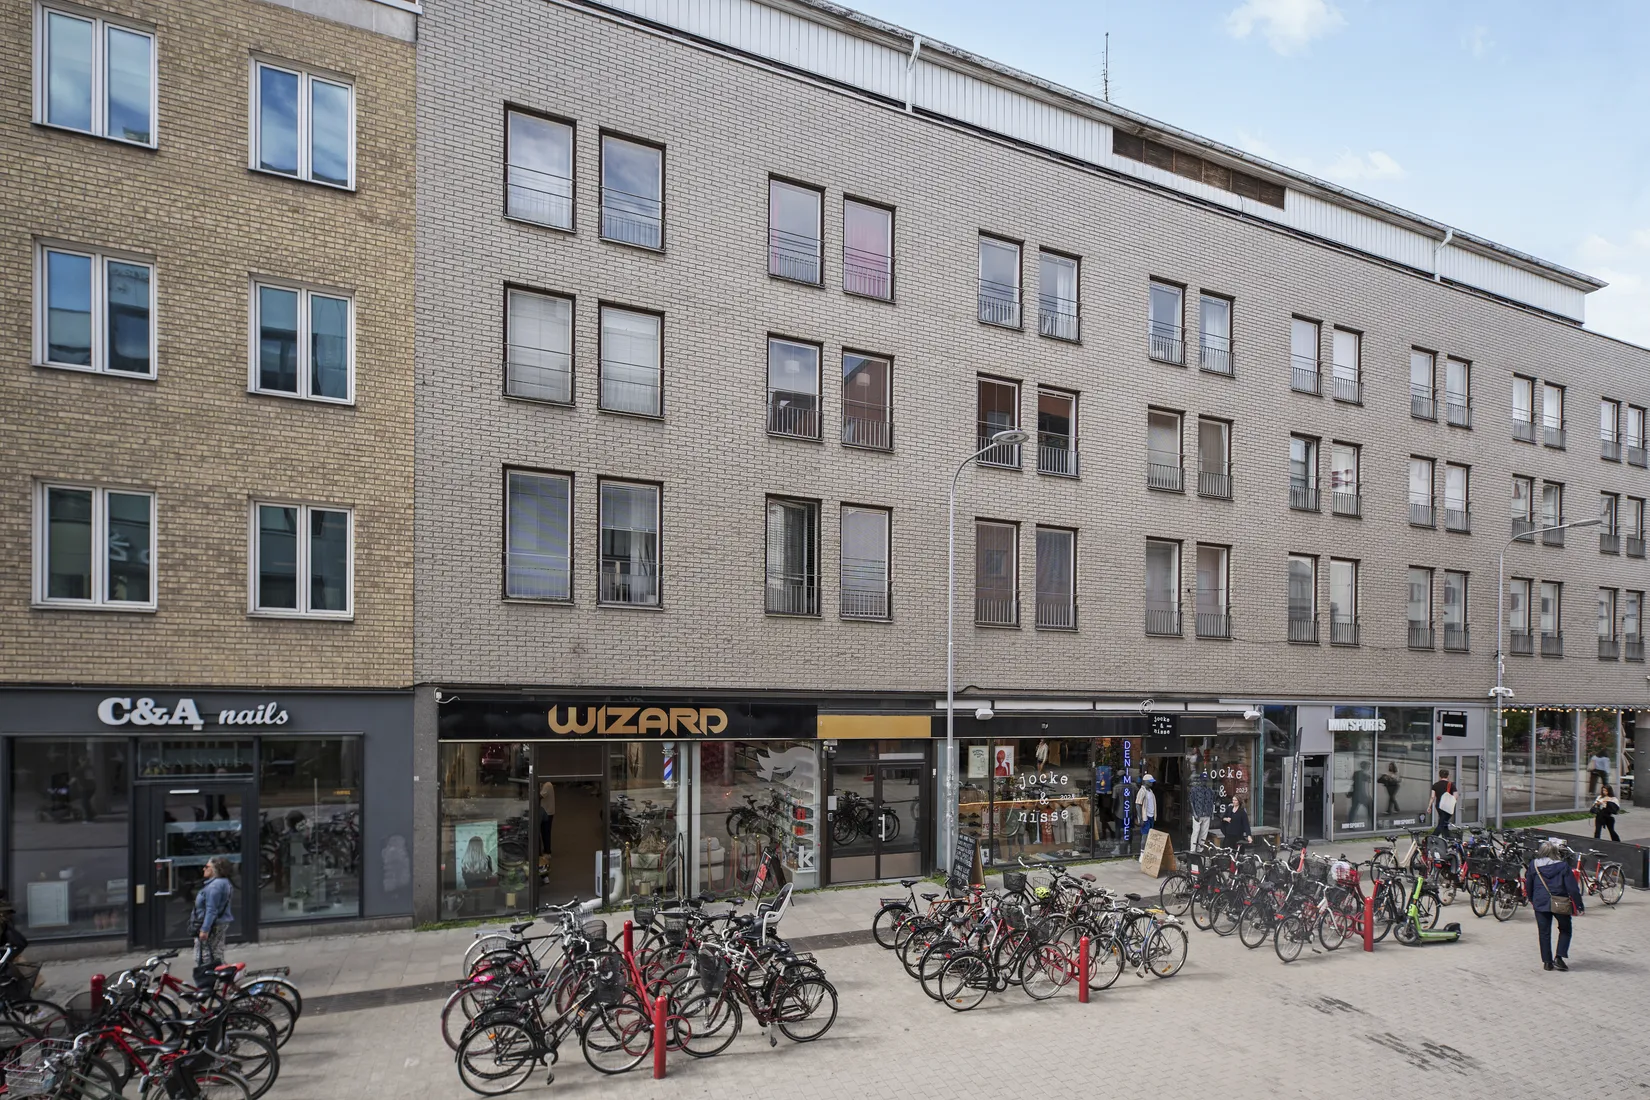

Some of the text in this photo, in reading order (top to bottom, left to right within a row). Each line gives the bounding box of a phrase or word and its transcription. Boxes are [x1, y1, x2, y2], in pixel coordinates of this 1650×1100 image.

[98, 697, 289, 725] C&A nails
[548, 704, 728, 736] WIZARD
[1123, 741, 1131, 784] DENIM
[1019, 771, 1068, 789] jocke
[1040, 792, 1049, 805] &
[1123, 788, 1131, 797] &
[1219, 785, 1228, 797] &
[1018, 809, 1069, 823] nisse
